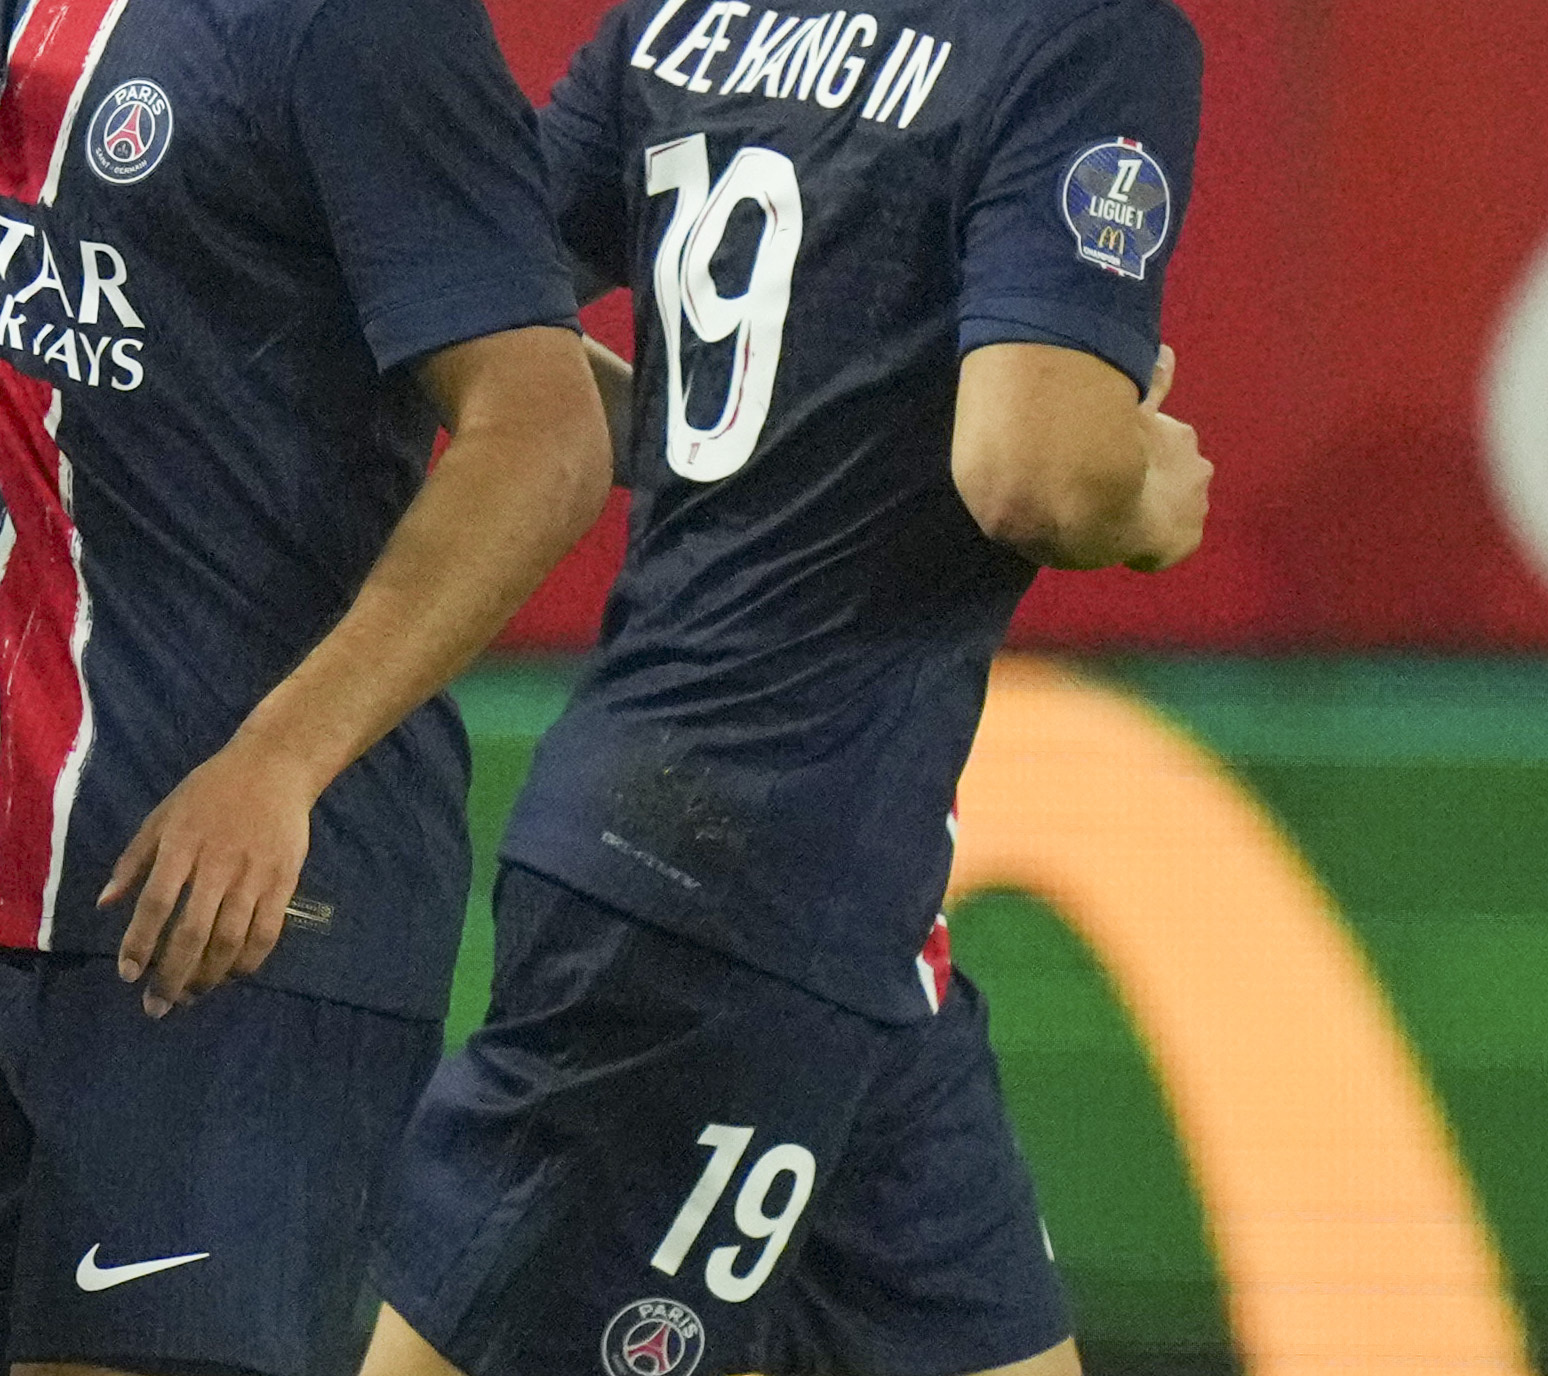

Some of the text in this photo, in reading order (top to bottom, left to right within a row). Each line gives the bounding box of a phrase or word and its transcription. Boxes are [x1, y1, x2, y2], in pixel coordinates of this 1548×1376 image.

[114, 85, 166, 115] PARIS
[718, 9, 878, 110] KANG
[861, 27, 952, 130] IN
[644, 132, 804, 482] 19
[650, 1124, 816, 1303] 19
[639, 1304, 698, 1339] PARIS
